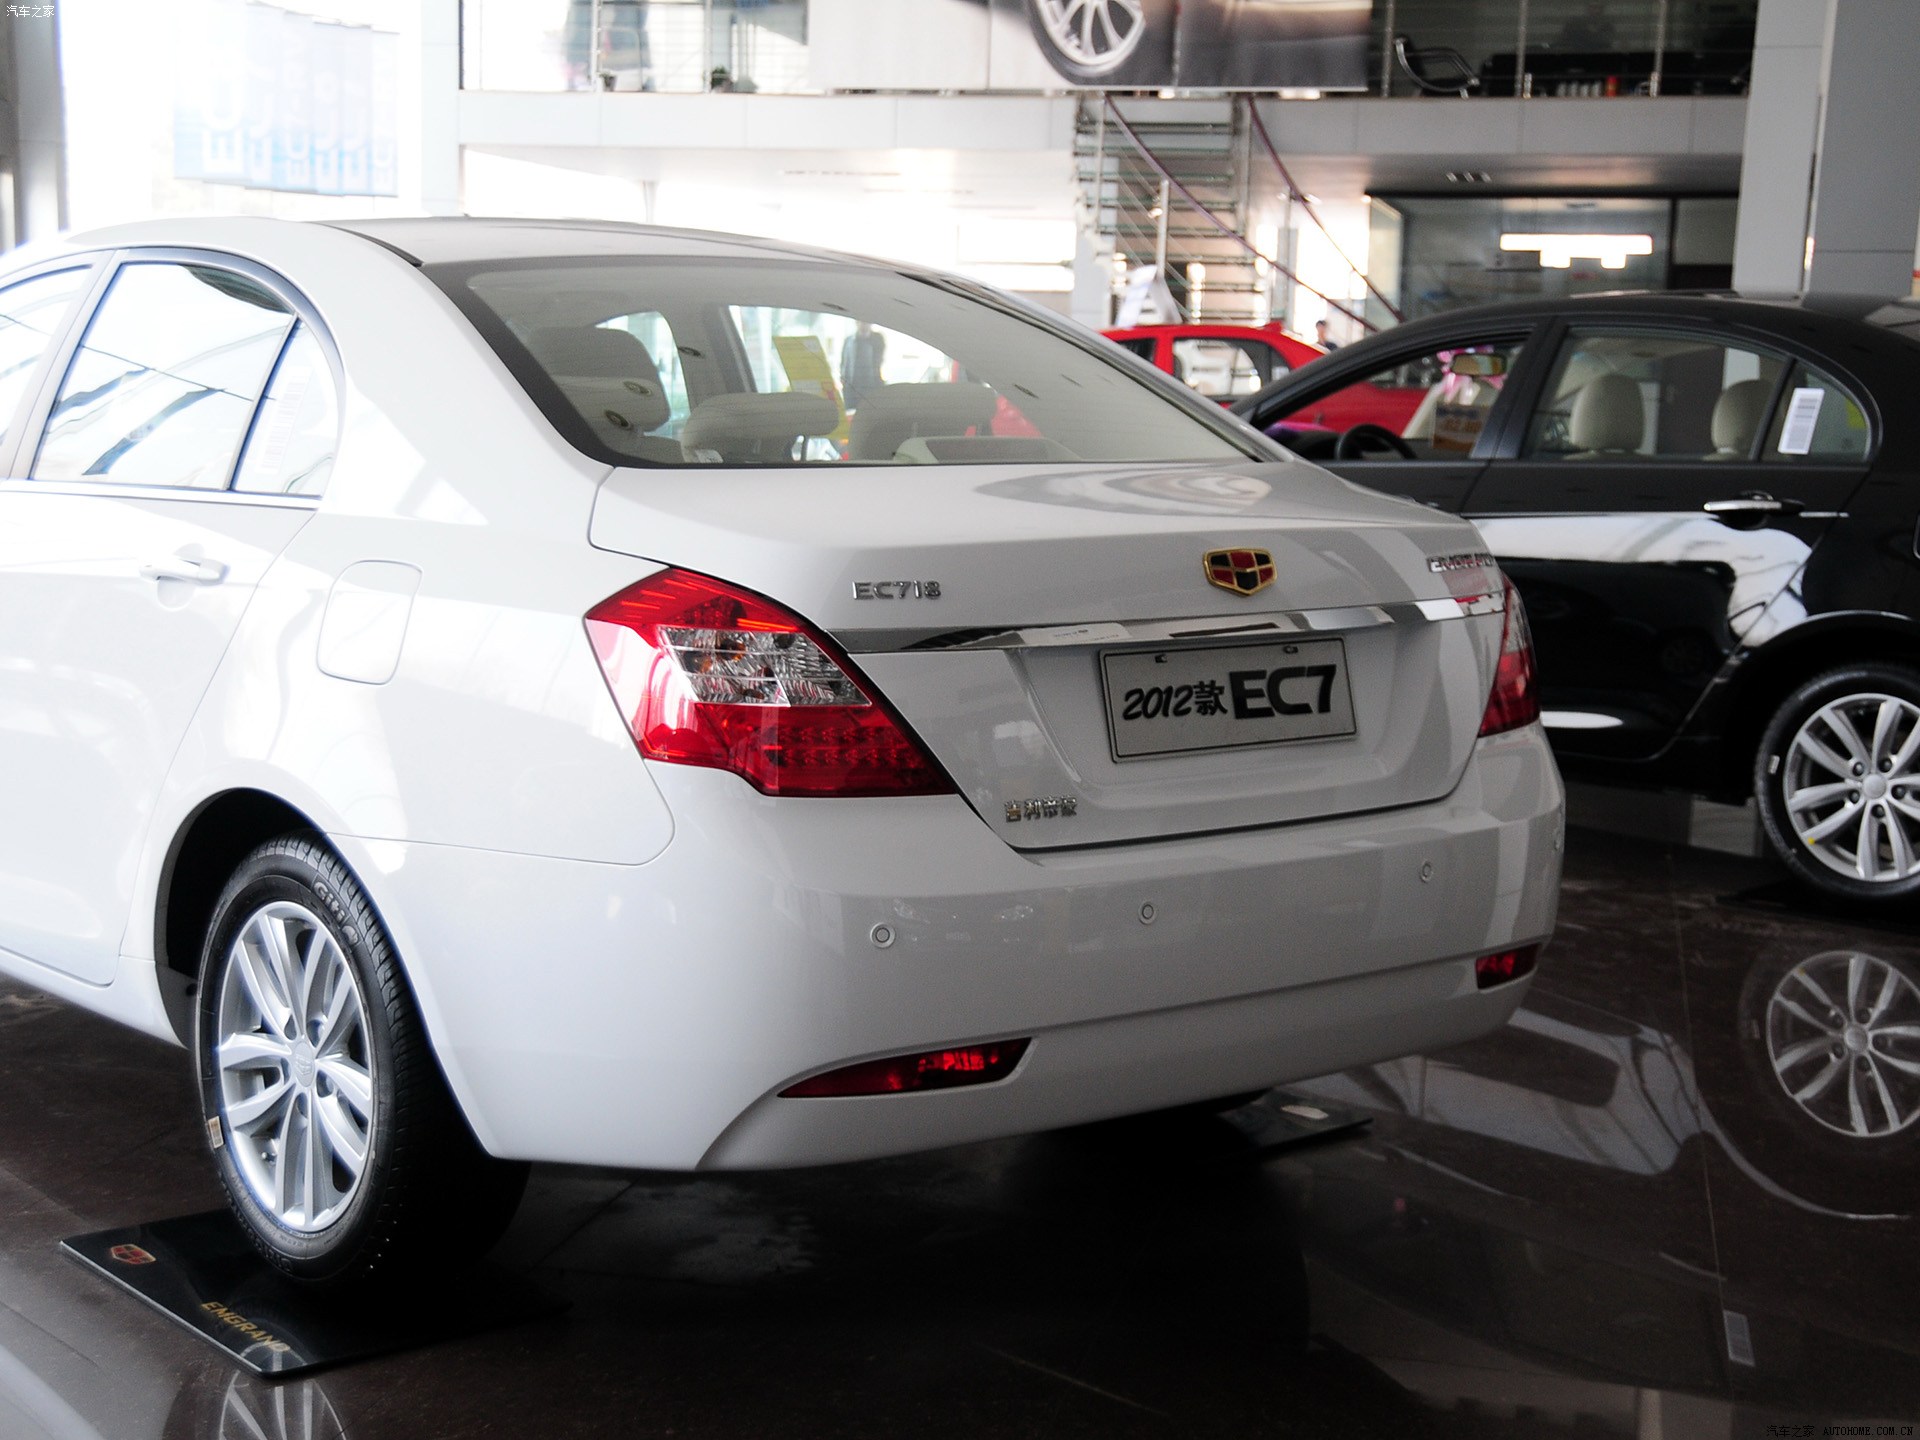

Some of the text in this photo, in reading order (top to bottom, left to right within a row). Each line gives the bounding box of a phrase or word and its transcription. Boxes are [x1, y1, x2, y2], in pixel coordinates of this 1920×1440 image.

[852, 580, 942, 599] EC718
[1229, 664, 1337, 720] EC7
[202, 1301, 291, 1352] EMGRAND
